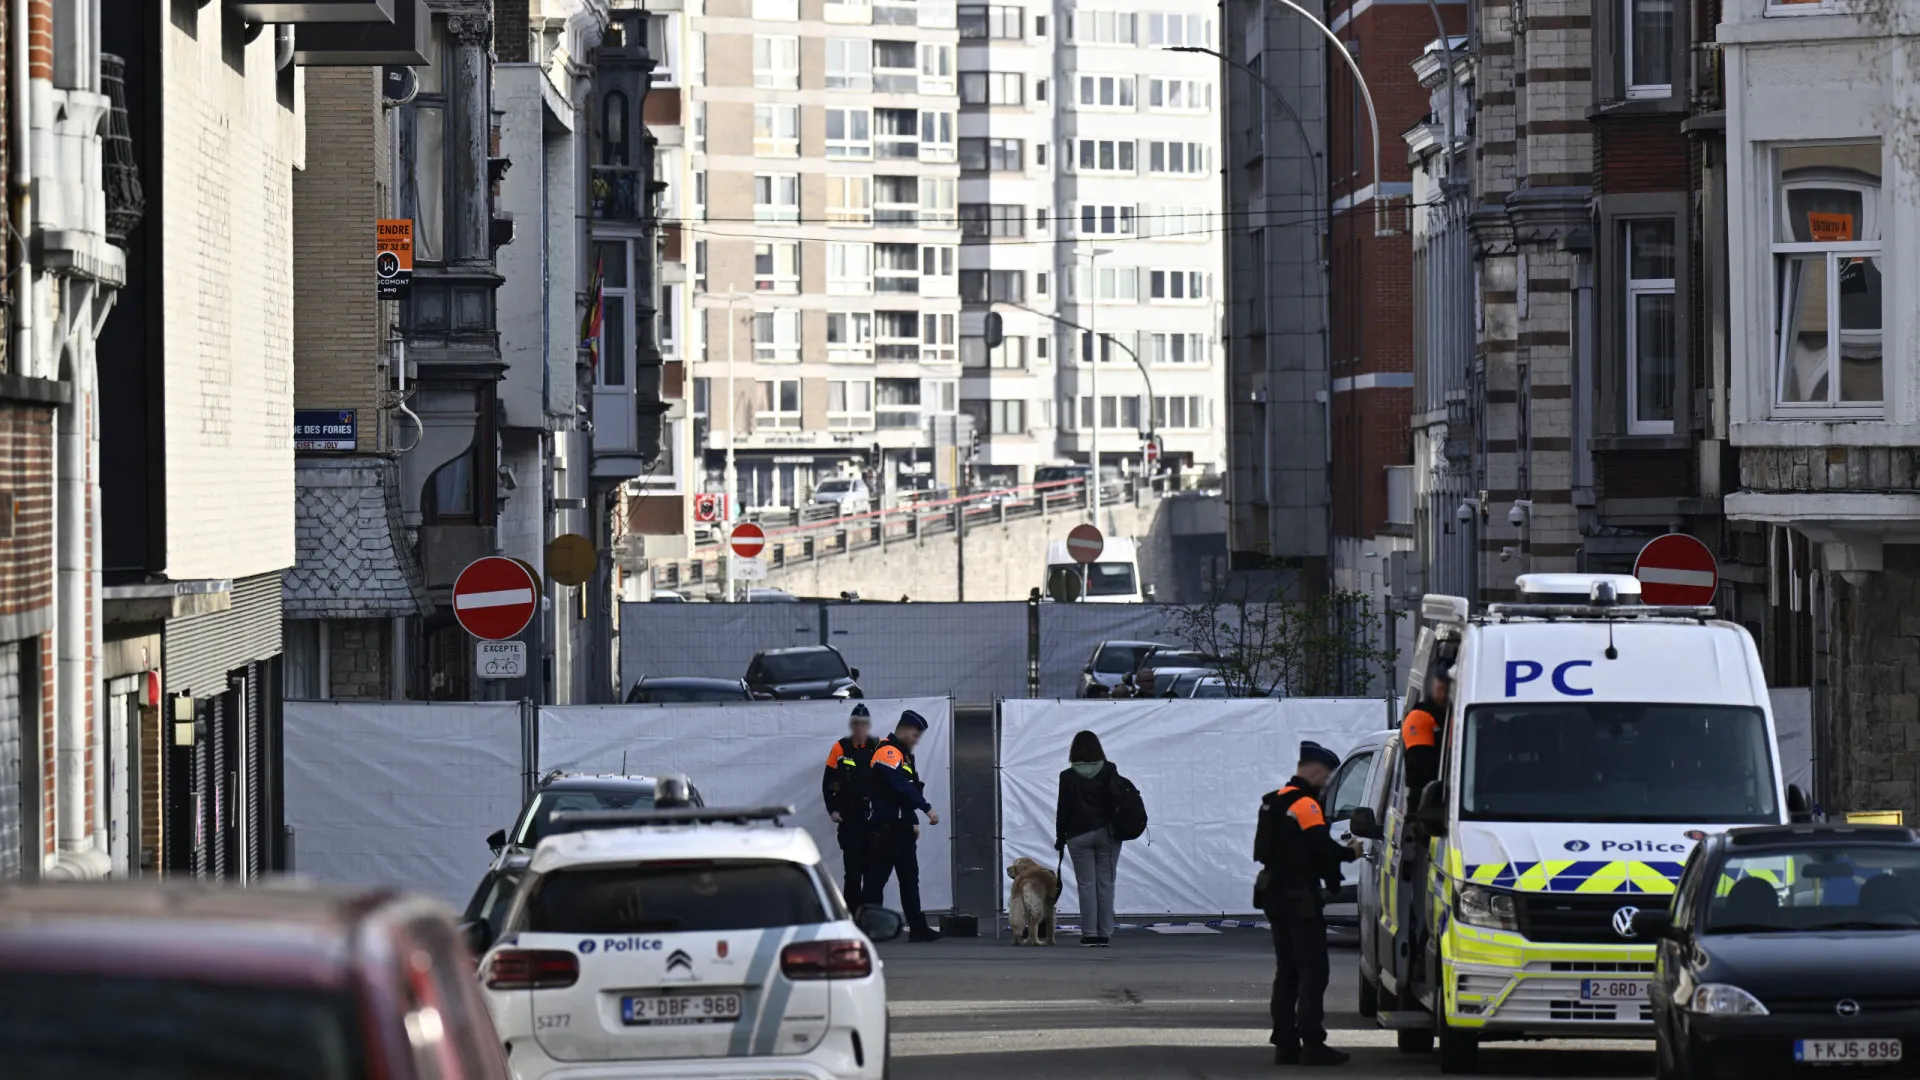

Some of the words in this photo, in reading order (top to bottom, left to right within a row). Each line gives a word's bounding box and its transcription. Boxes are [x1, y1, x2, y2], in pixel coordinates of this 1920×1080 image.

[390, 243, 399, 251] 32
[400, 243, 410, 251] 82
[304, 425, 320, 434] DES
[322, 425, 352, 434] FORIES
[324, 441, 338, 449] JOLY
[484, 644, 519, 653] EXCEPTE
[1505, 660, 1594, 697] PC
[1602, 840, 1685, 852] Police
[604, 937, 663, 951] Police
